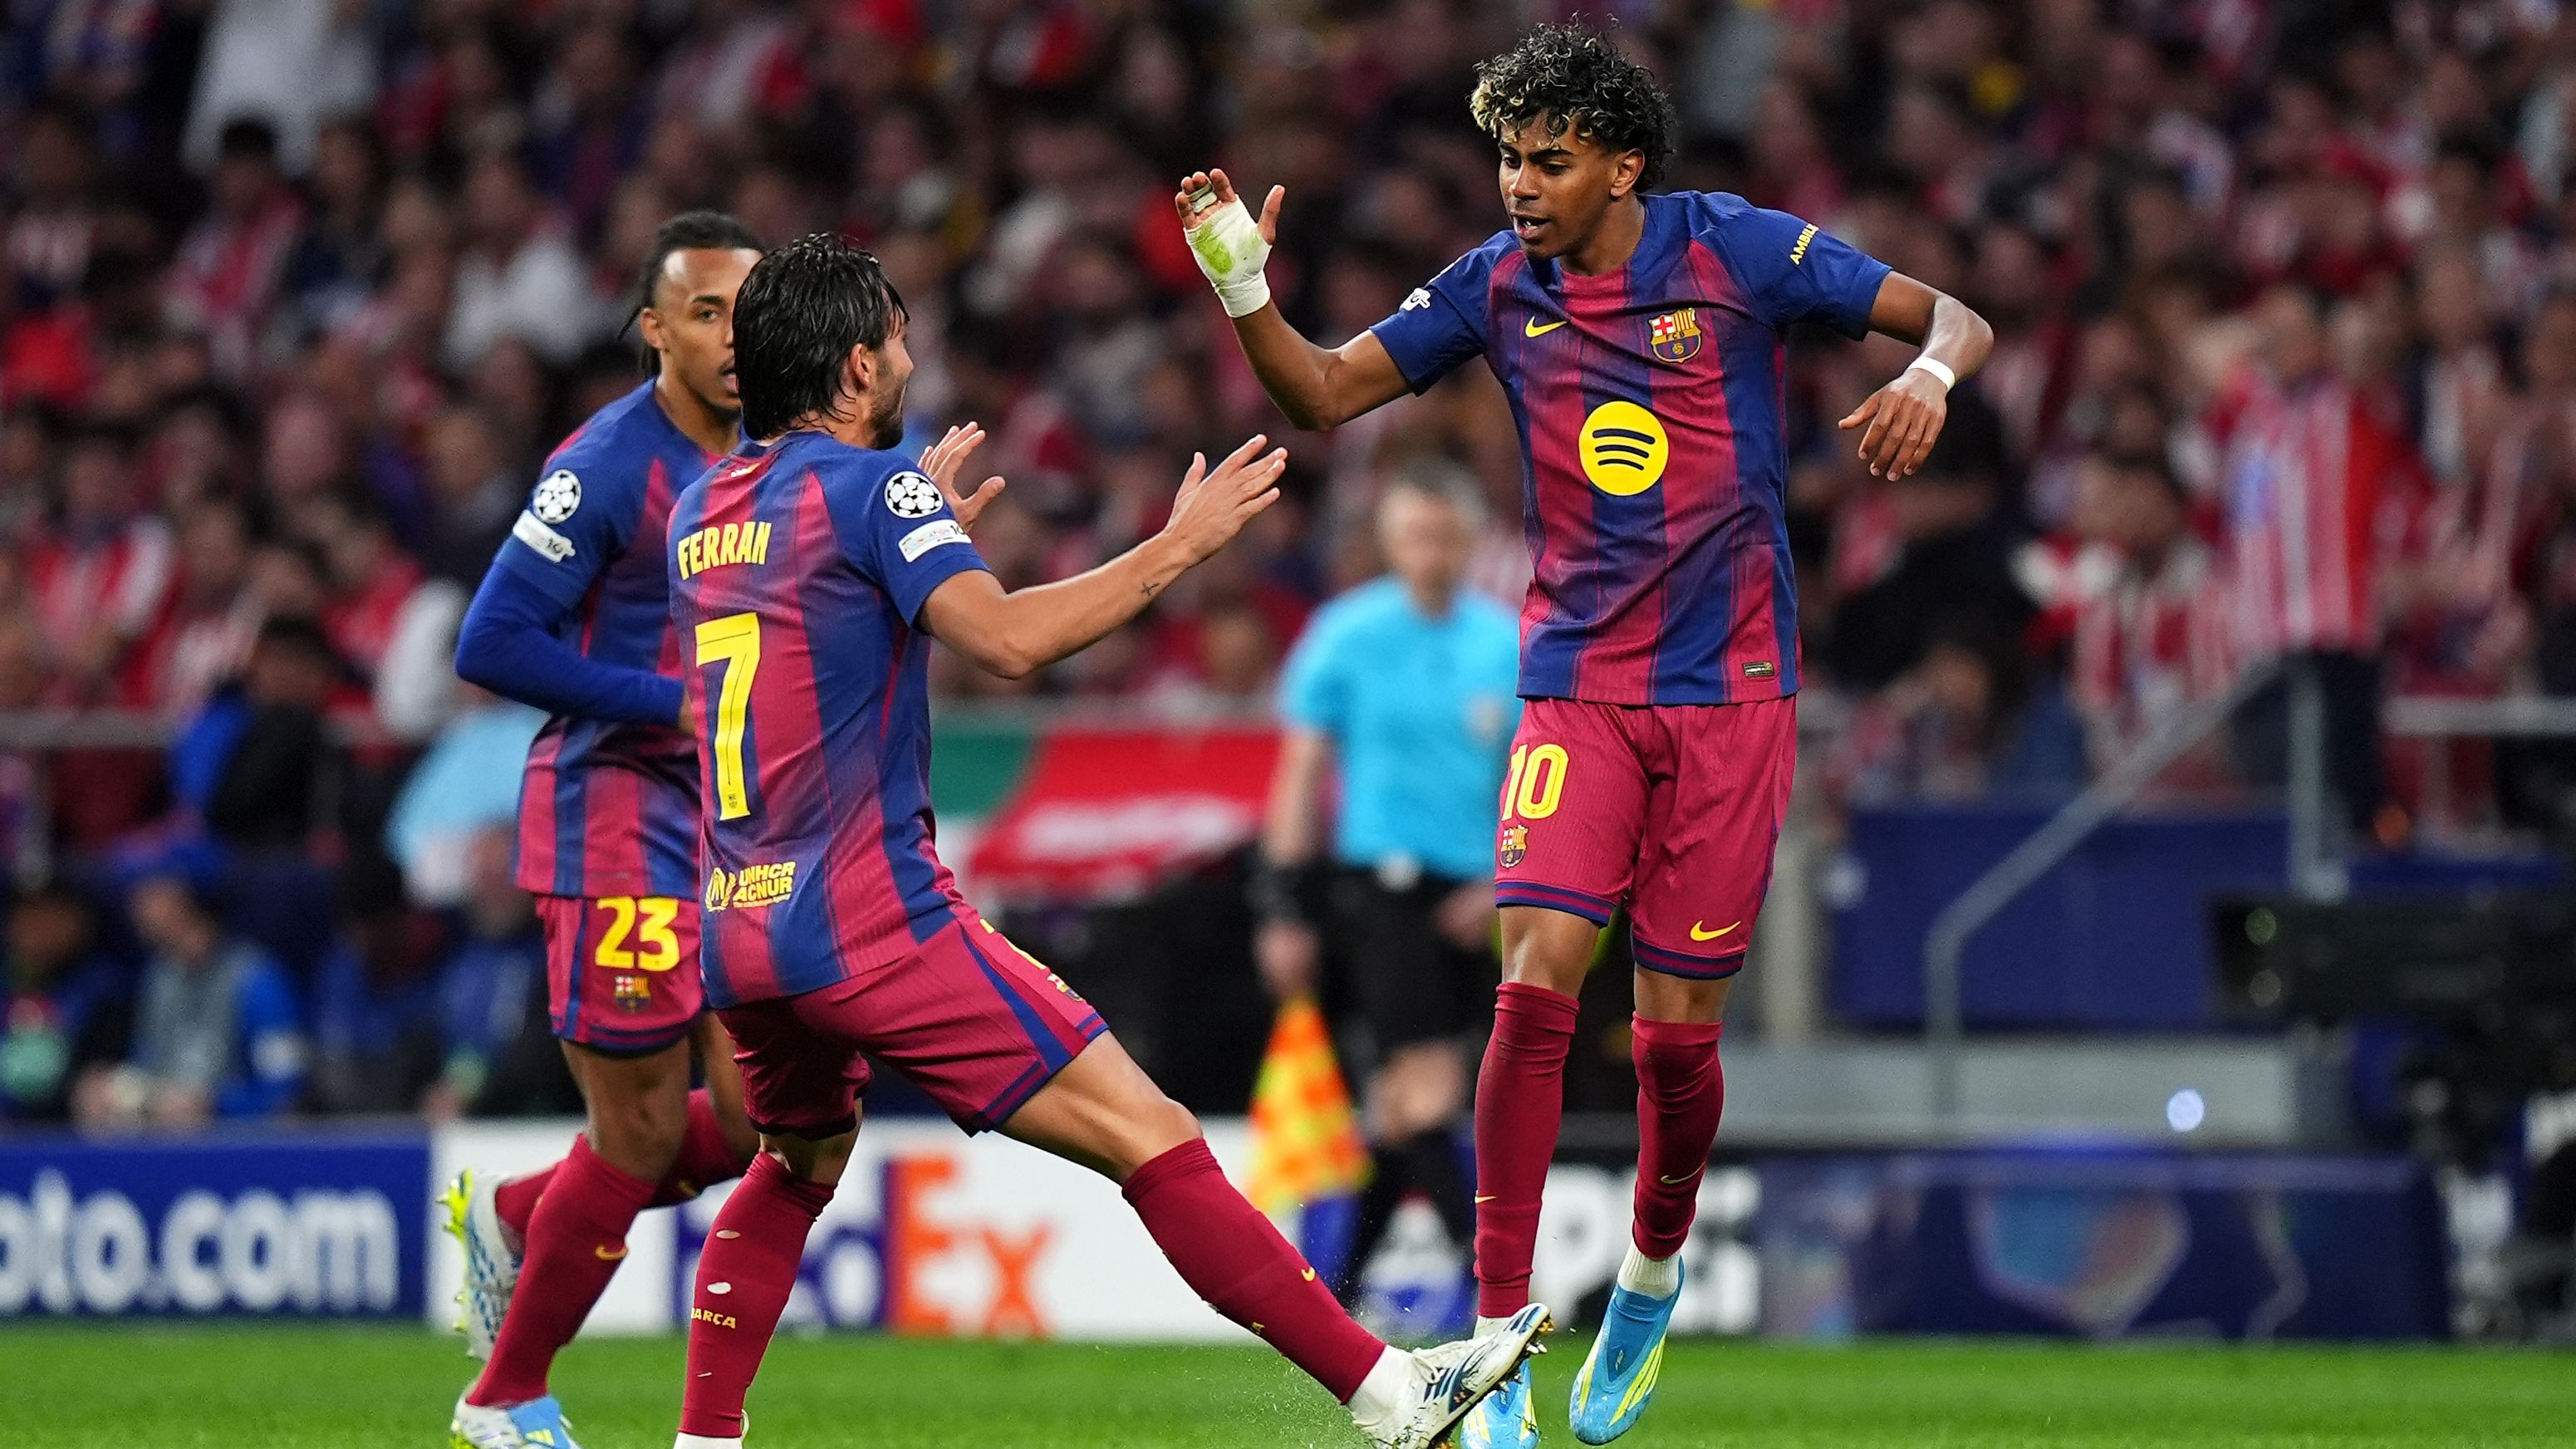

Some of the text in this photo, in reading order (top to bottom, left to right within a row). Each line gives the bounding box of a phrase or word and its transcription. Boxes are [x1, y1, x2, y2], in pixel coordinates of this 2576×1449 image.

[678, 521, 773, 581] FERRAN
[694, 612, 761, 821] 7
[1501, 744, 1569, 821] 10
[733, 877, 792, 901] ACNUR
[738, 861, 796, 887] UNHCR
[595, 896, 680, 972] 23
